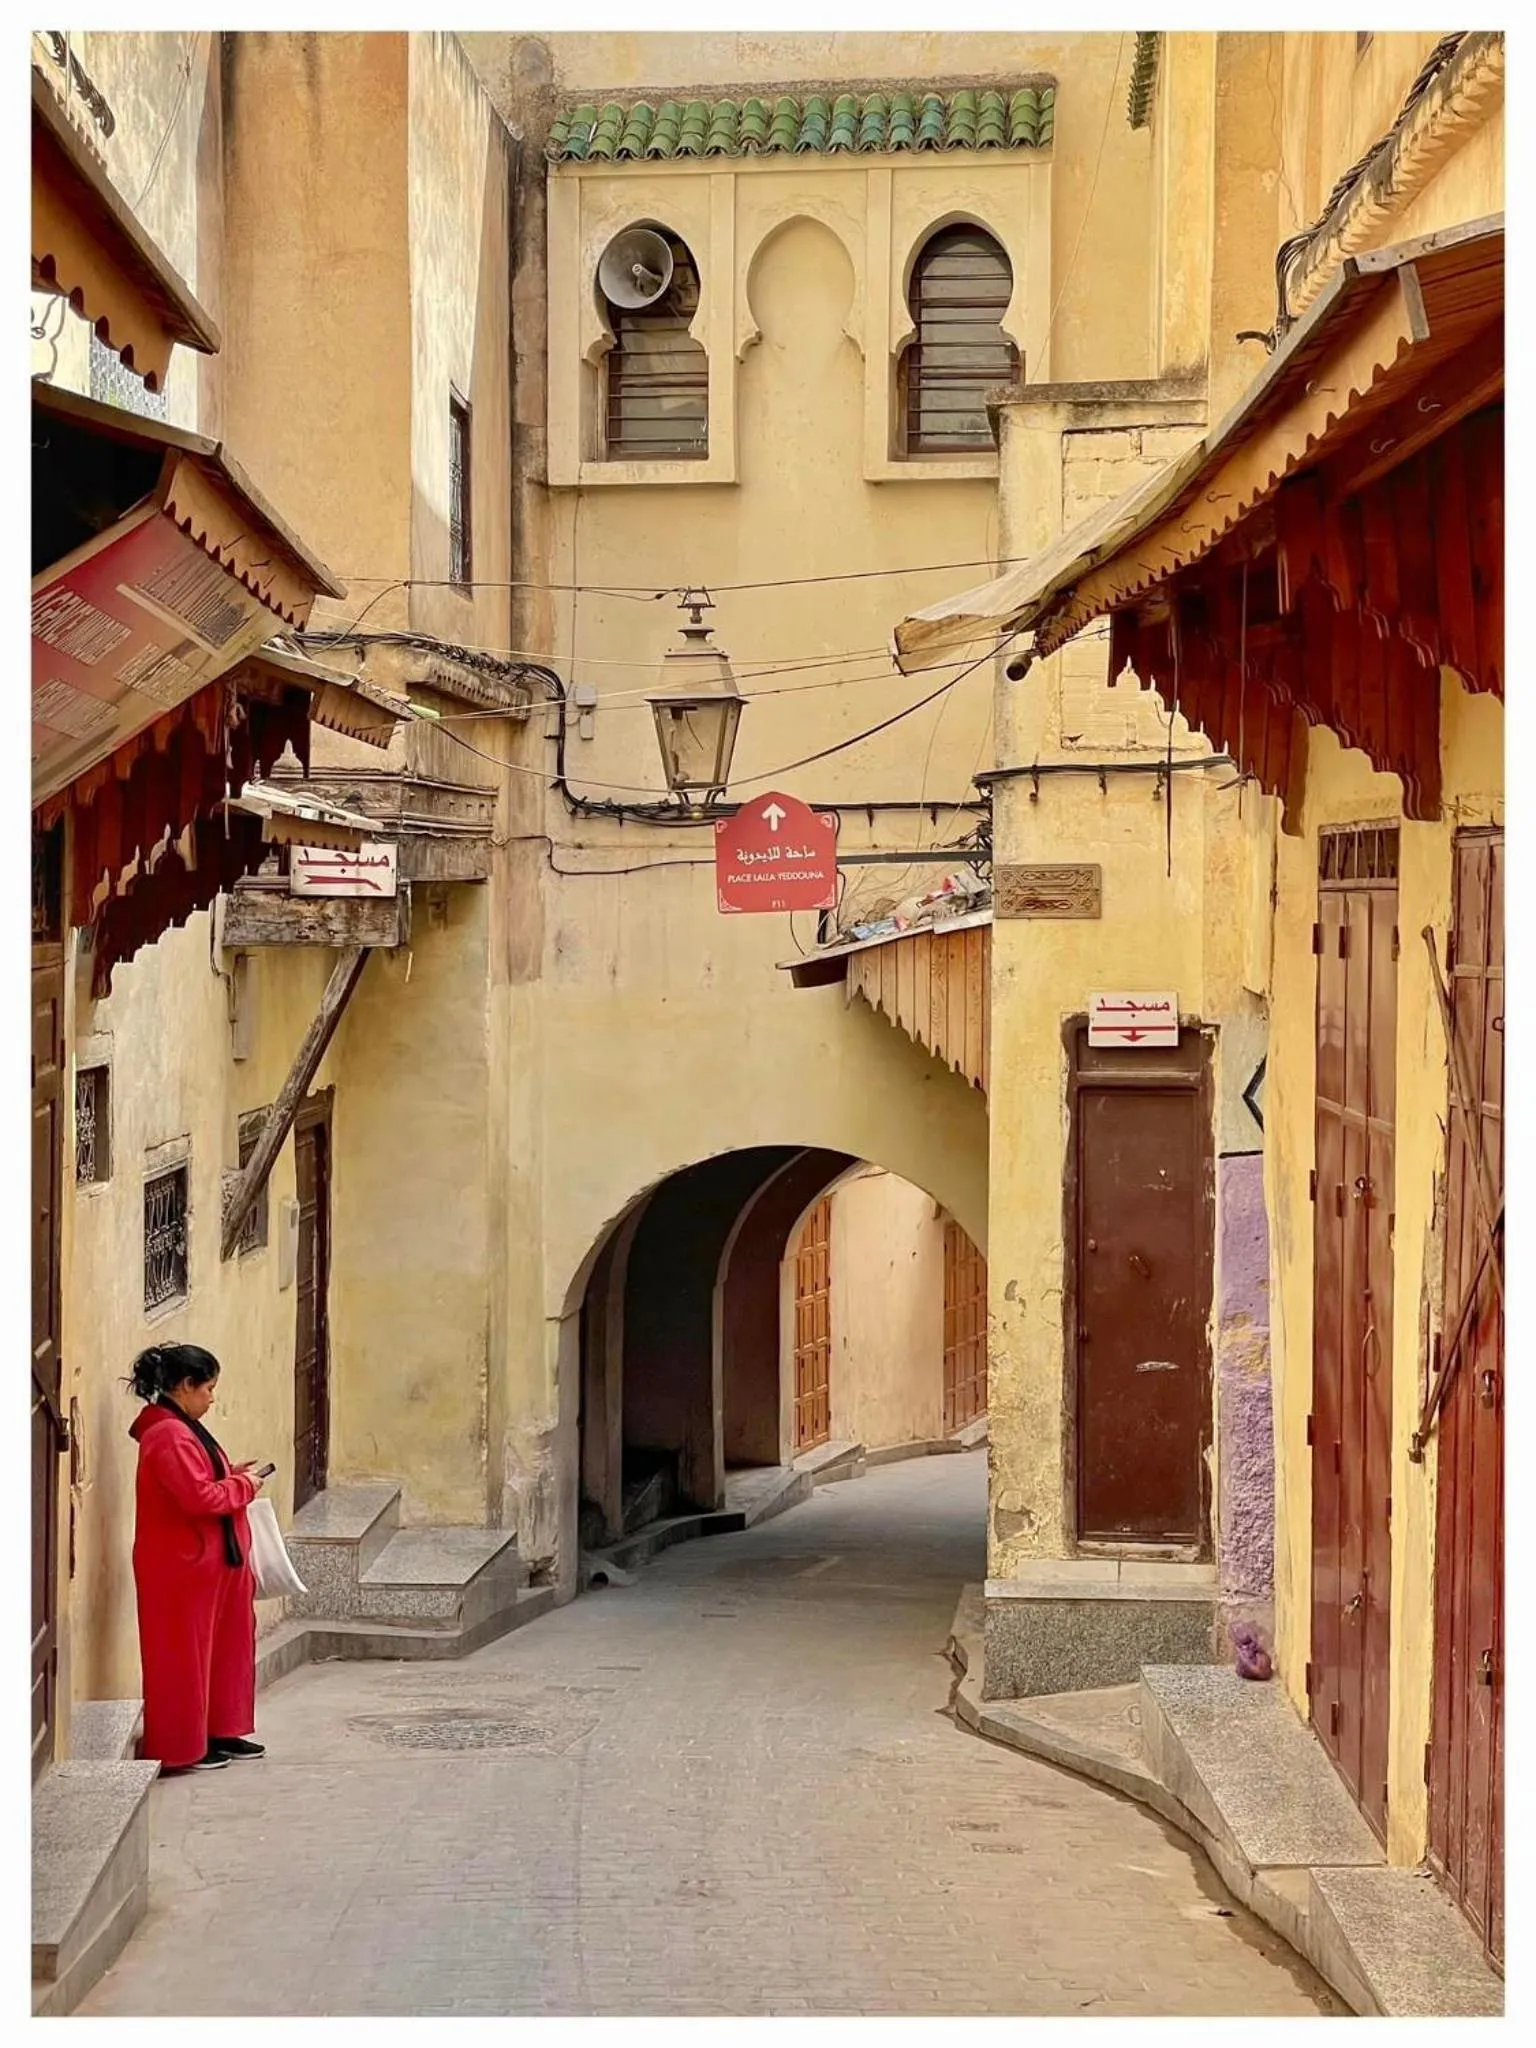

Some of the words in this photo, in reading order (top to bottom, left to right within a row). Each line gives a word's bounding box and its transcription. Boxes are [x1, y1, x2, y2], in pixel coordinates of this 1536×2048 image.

[786, 845, 816, 859] ساحة
[298, 848, 390, 874] مسجد
[727, 874, 752, 883] PLACE
[753, 872, 775, 882] LALLA
[778, 870, 824, 880] YEDDOUNA
[1096, 997, 1170, 1018] مسجد
